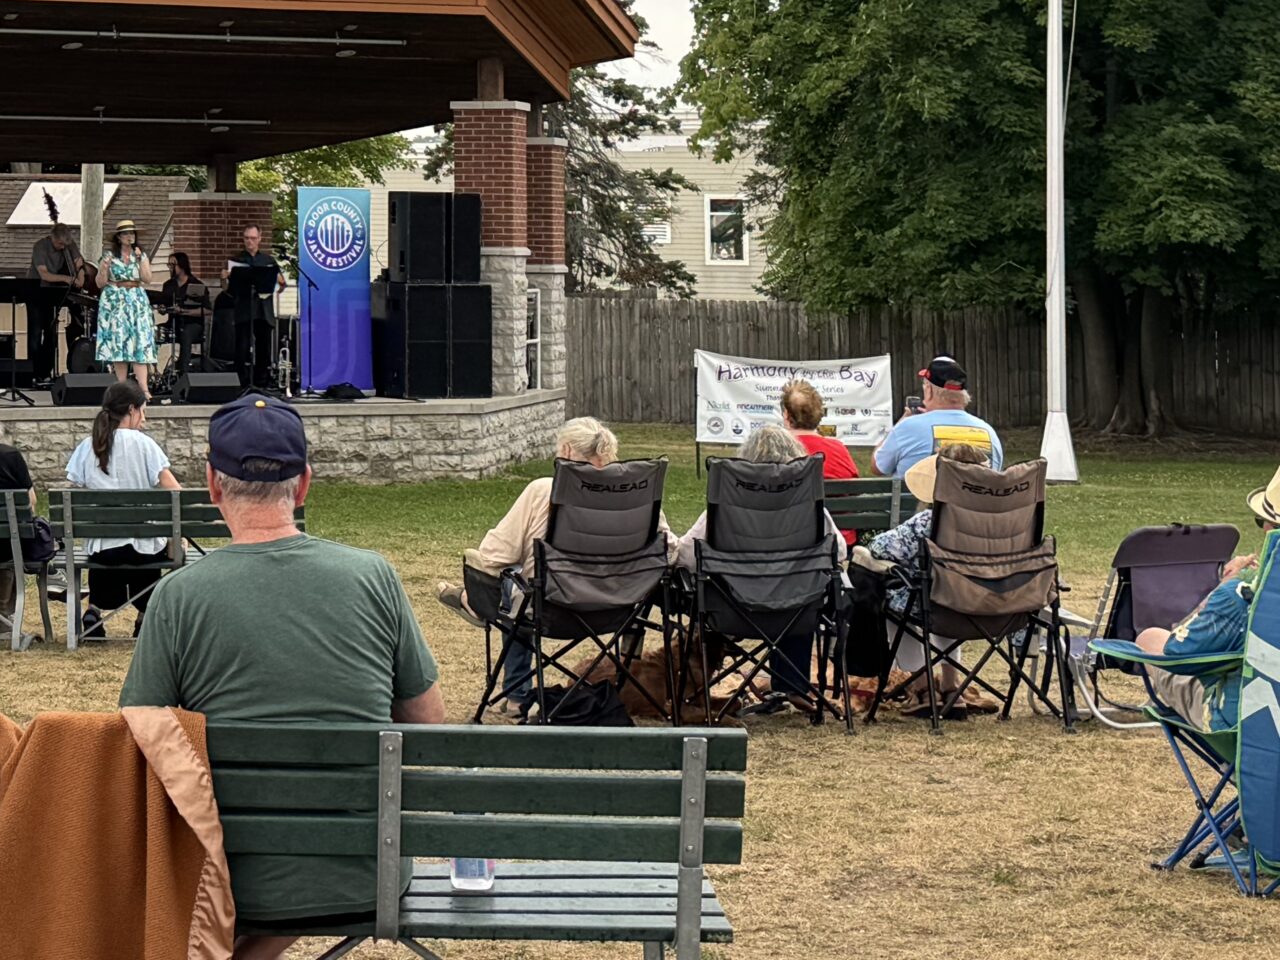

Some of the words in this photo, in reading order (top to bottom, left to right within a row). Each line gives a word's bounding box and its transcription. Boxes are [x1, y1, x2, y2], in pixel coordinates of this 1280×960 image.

[308, 203, 330, 228] DOOR
[331, 201, 363, 229] COUNTY
[308, 239, 326, 263] JAZZ
[326, 239, 364, 267] FESTIVAL
[717, 364, 798, 381] Harmony
[839, 365, 877, 388] Bay
[581, 479, 649, 493] REALEAD
[961, 481, 1030, 497] REALEAD
